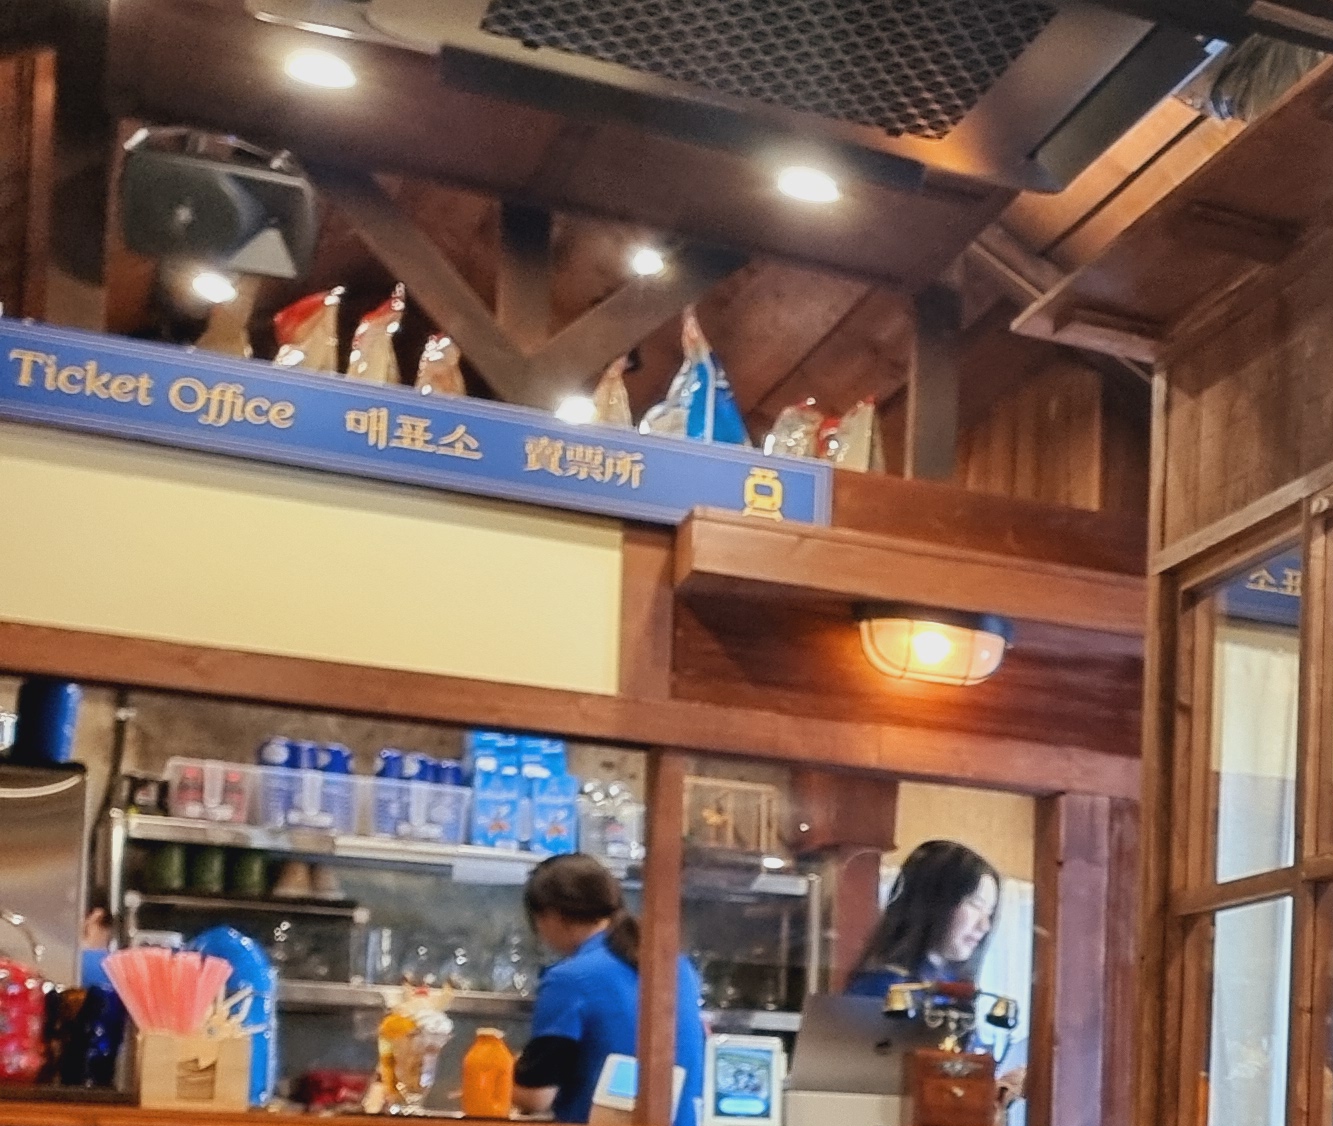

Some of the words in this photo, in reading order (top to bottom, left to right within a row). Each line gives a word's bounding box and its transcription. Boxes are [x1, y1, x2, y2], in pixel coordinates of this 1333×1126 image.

[9, 348, 154, 406] Ticket
[168, 377, 295, 428] Office
[345, 407, 484, 460] 매표소
